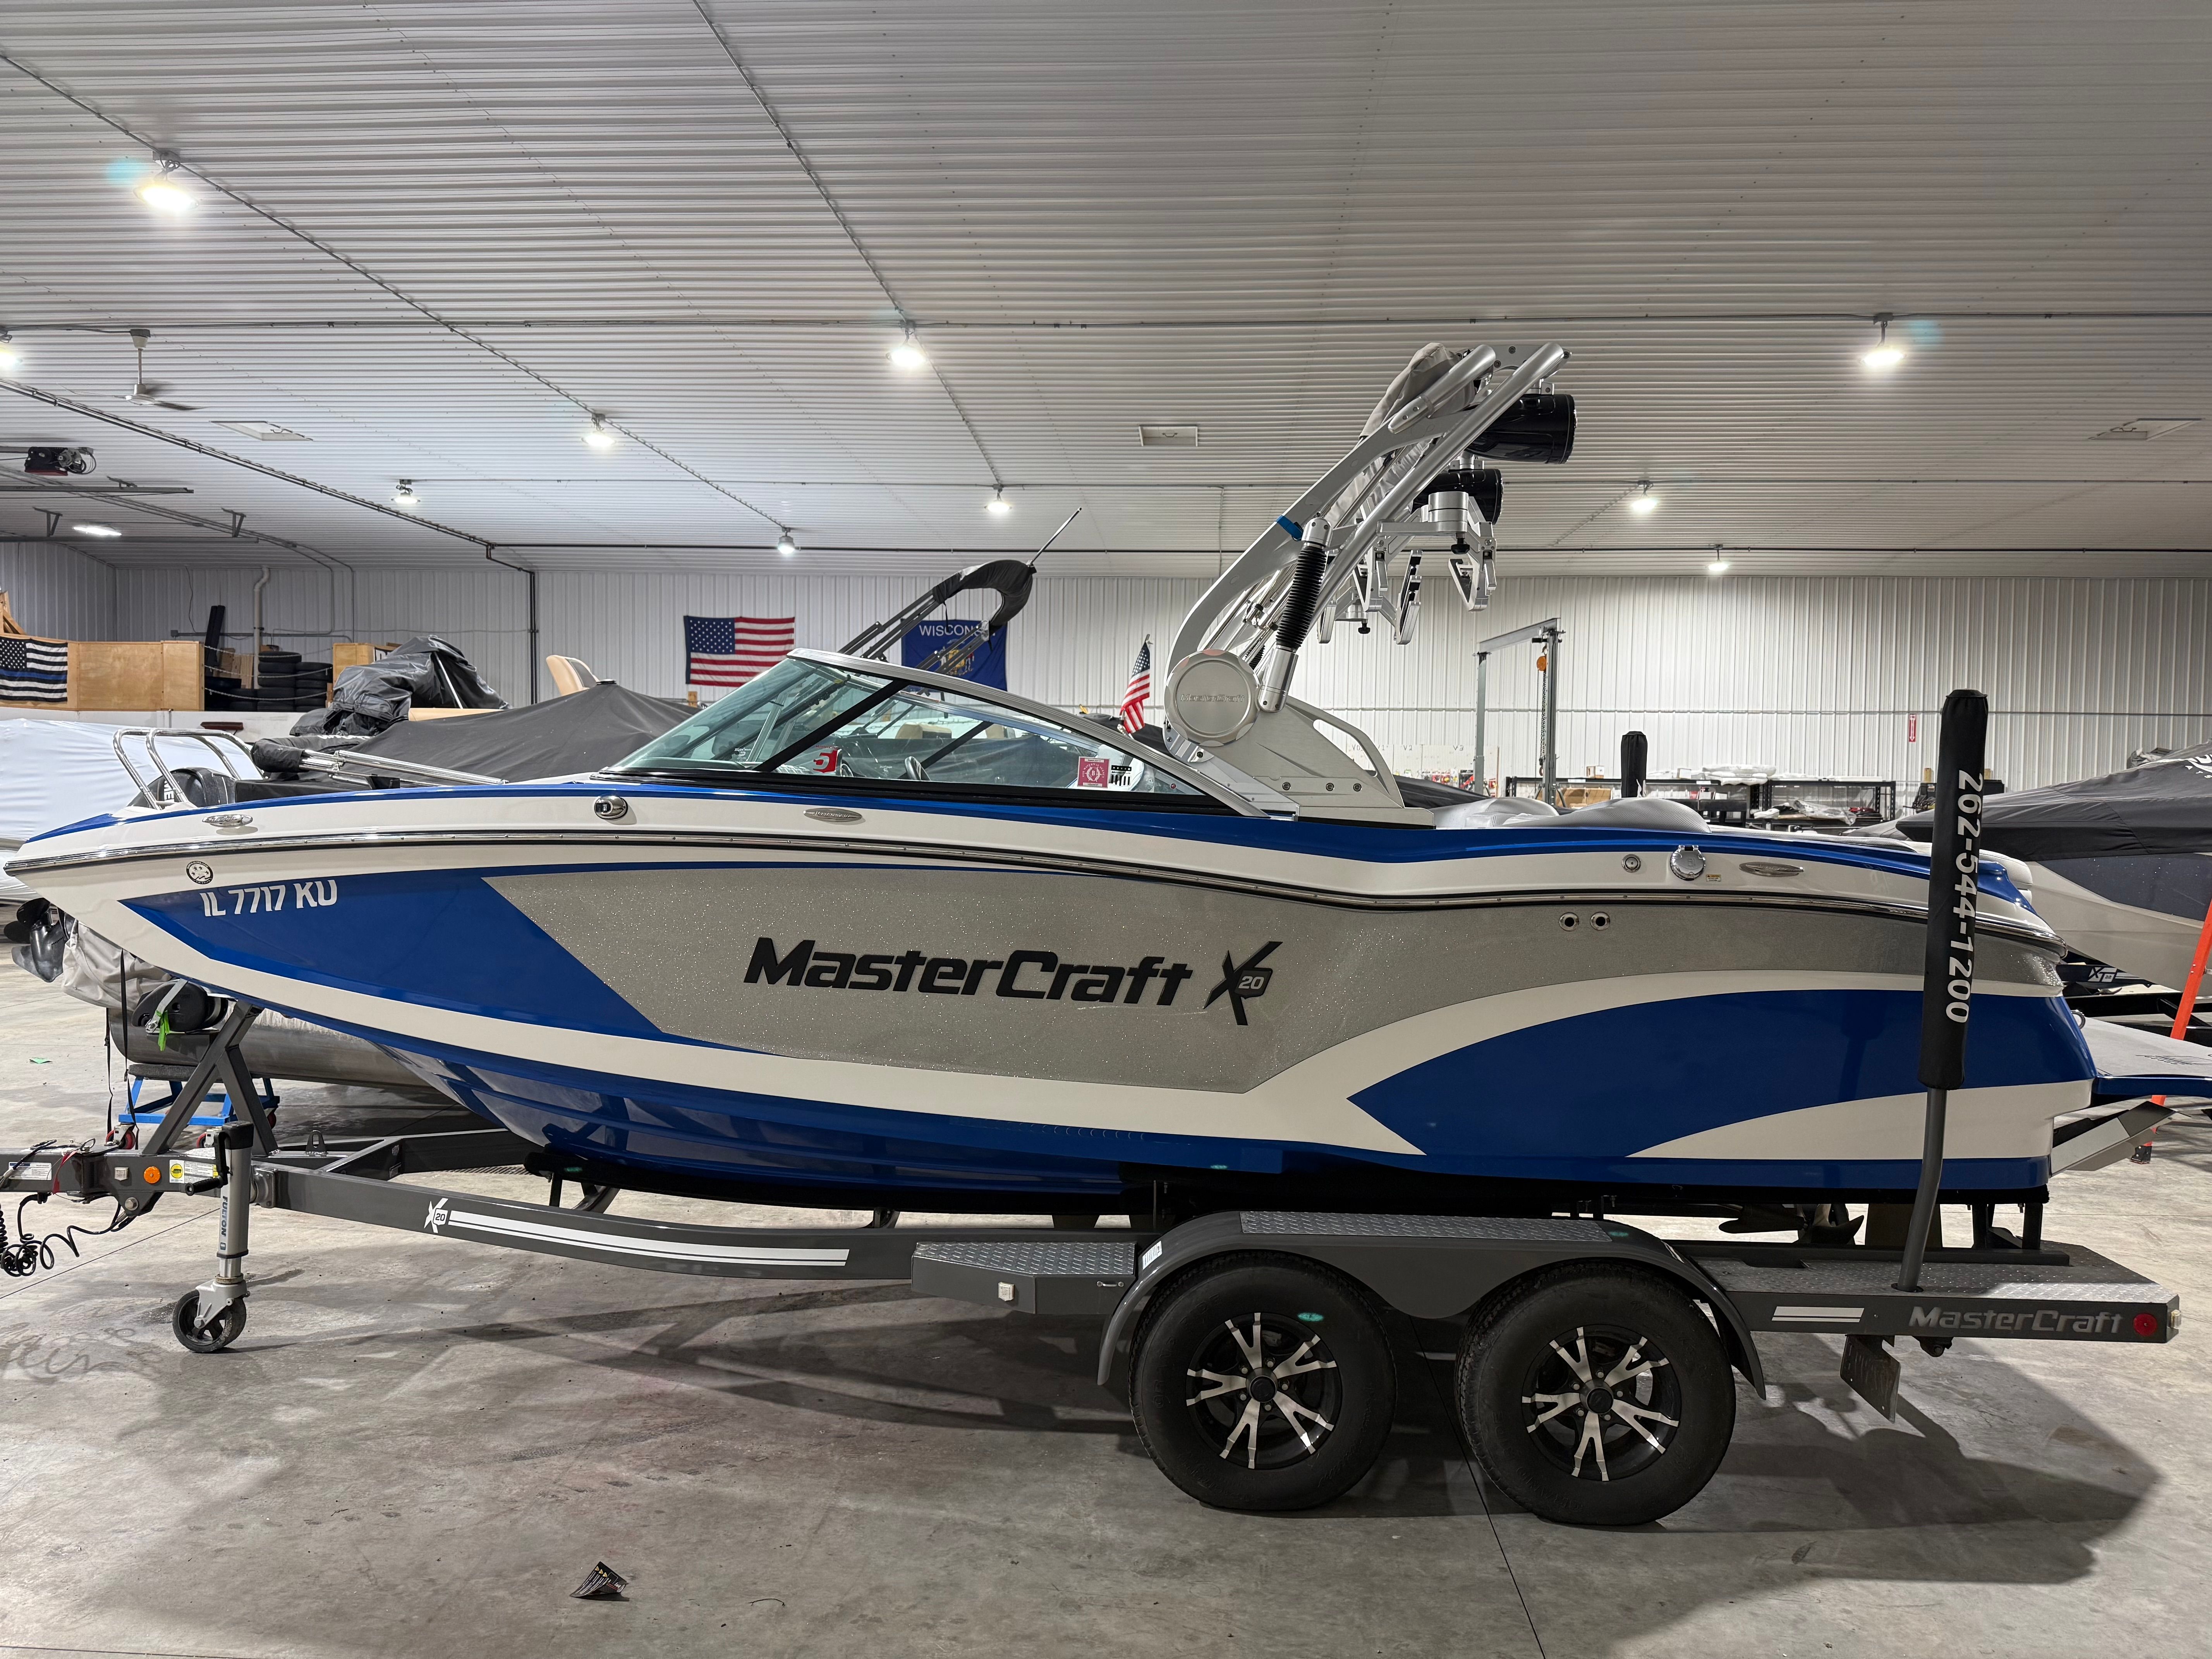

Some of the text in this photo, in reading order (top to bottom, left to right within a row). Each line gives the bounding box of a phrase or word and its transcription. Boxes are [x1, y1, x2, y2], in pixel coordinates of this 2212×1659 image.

[199, 879, 337, 917] IL 7717 KU
[1946, 770, 1983, 1023] 262-544-1200
[743, 937, 1194, 1006] MasterCraft
[1238, 975, 1262, 990] 20
[435, 1213, 445, 1221] 20
[1908, 1306, 2124, 1334] MasterCraft
